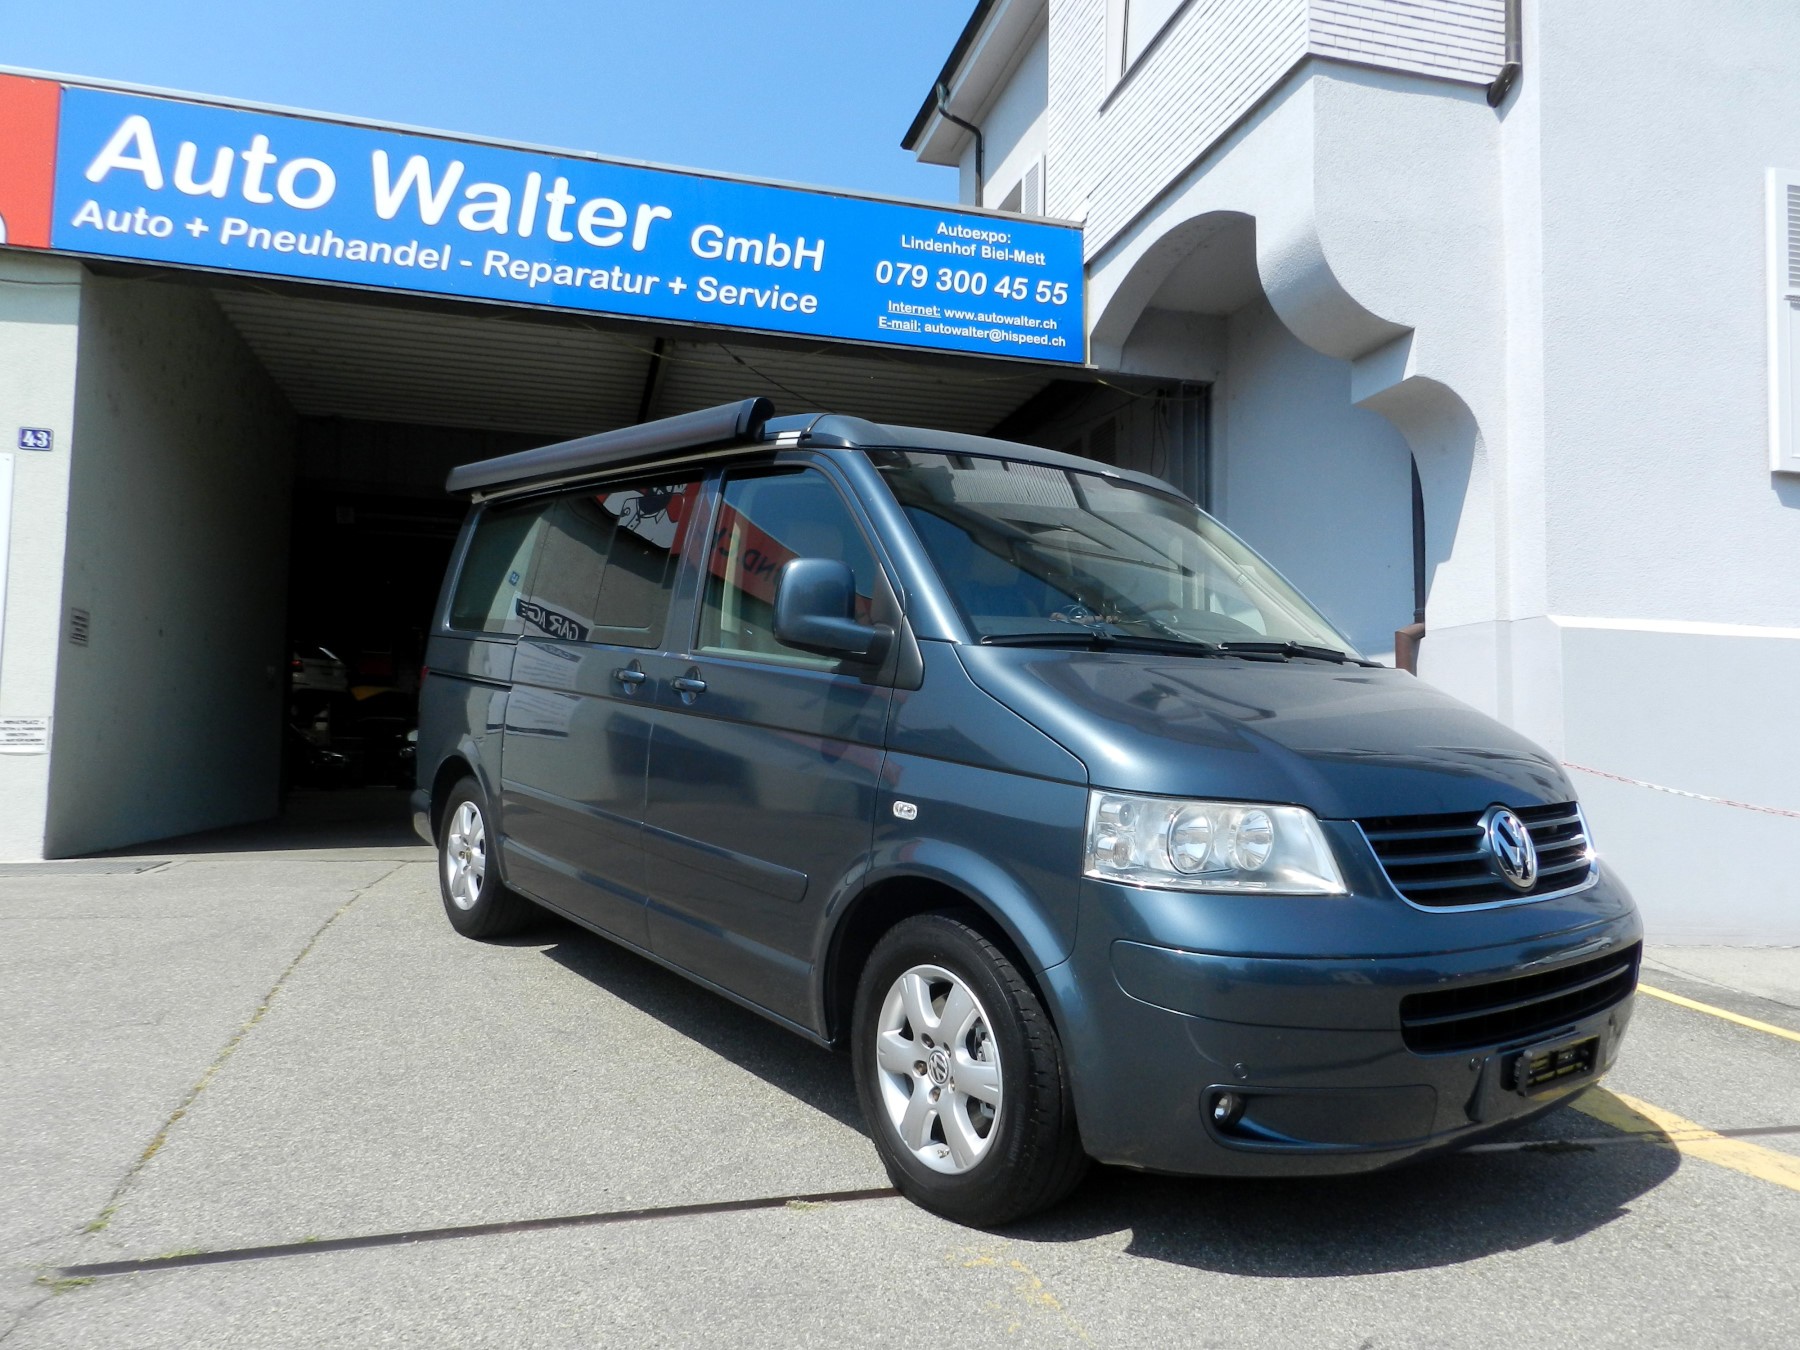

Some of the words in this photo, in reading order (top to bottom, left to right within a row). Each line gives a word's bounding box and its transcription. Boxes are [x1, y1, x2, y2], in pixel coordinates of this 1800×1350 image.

[84, 114, 337, 211] Auto
[371, 149, 673, 252] Walter
[690, 224, 825, 272] GmbH
[937, 222, 1012, 245] Autoexpo:
[71, 199, 174, 238] Auto
[185, 217, 210, 240] +
[219, 217, 452, 272] Pneuhandel
[483, 249, 660, 295] Reparatur
[668, 276, 687, 295] +
[696, 276, 818, 314] Service
[901, 235, 977, 257] Lindenhof
[981, 245, 1046, 266] Biel-Mett
[875, 260, 931, 288] 079
[935, 268, 988, 296] 300
[993, 275, 1029, 300] 45
[1035, 280, 1069, 305] 55
[887, 300, 942, 318] Internet:
[943, 308, 1057, 330] www.autowalter.ch
[878, 316, 922, 333] E-mail:
[924, 322, 1067, 347] autowalter@hispeed.ch
[22, 430, 48, 448] 43
